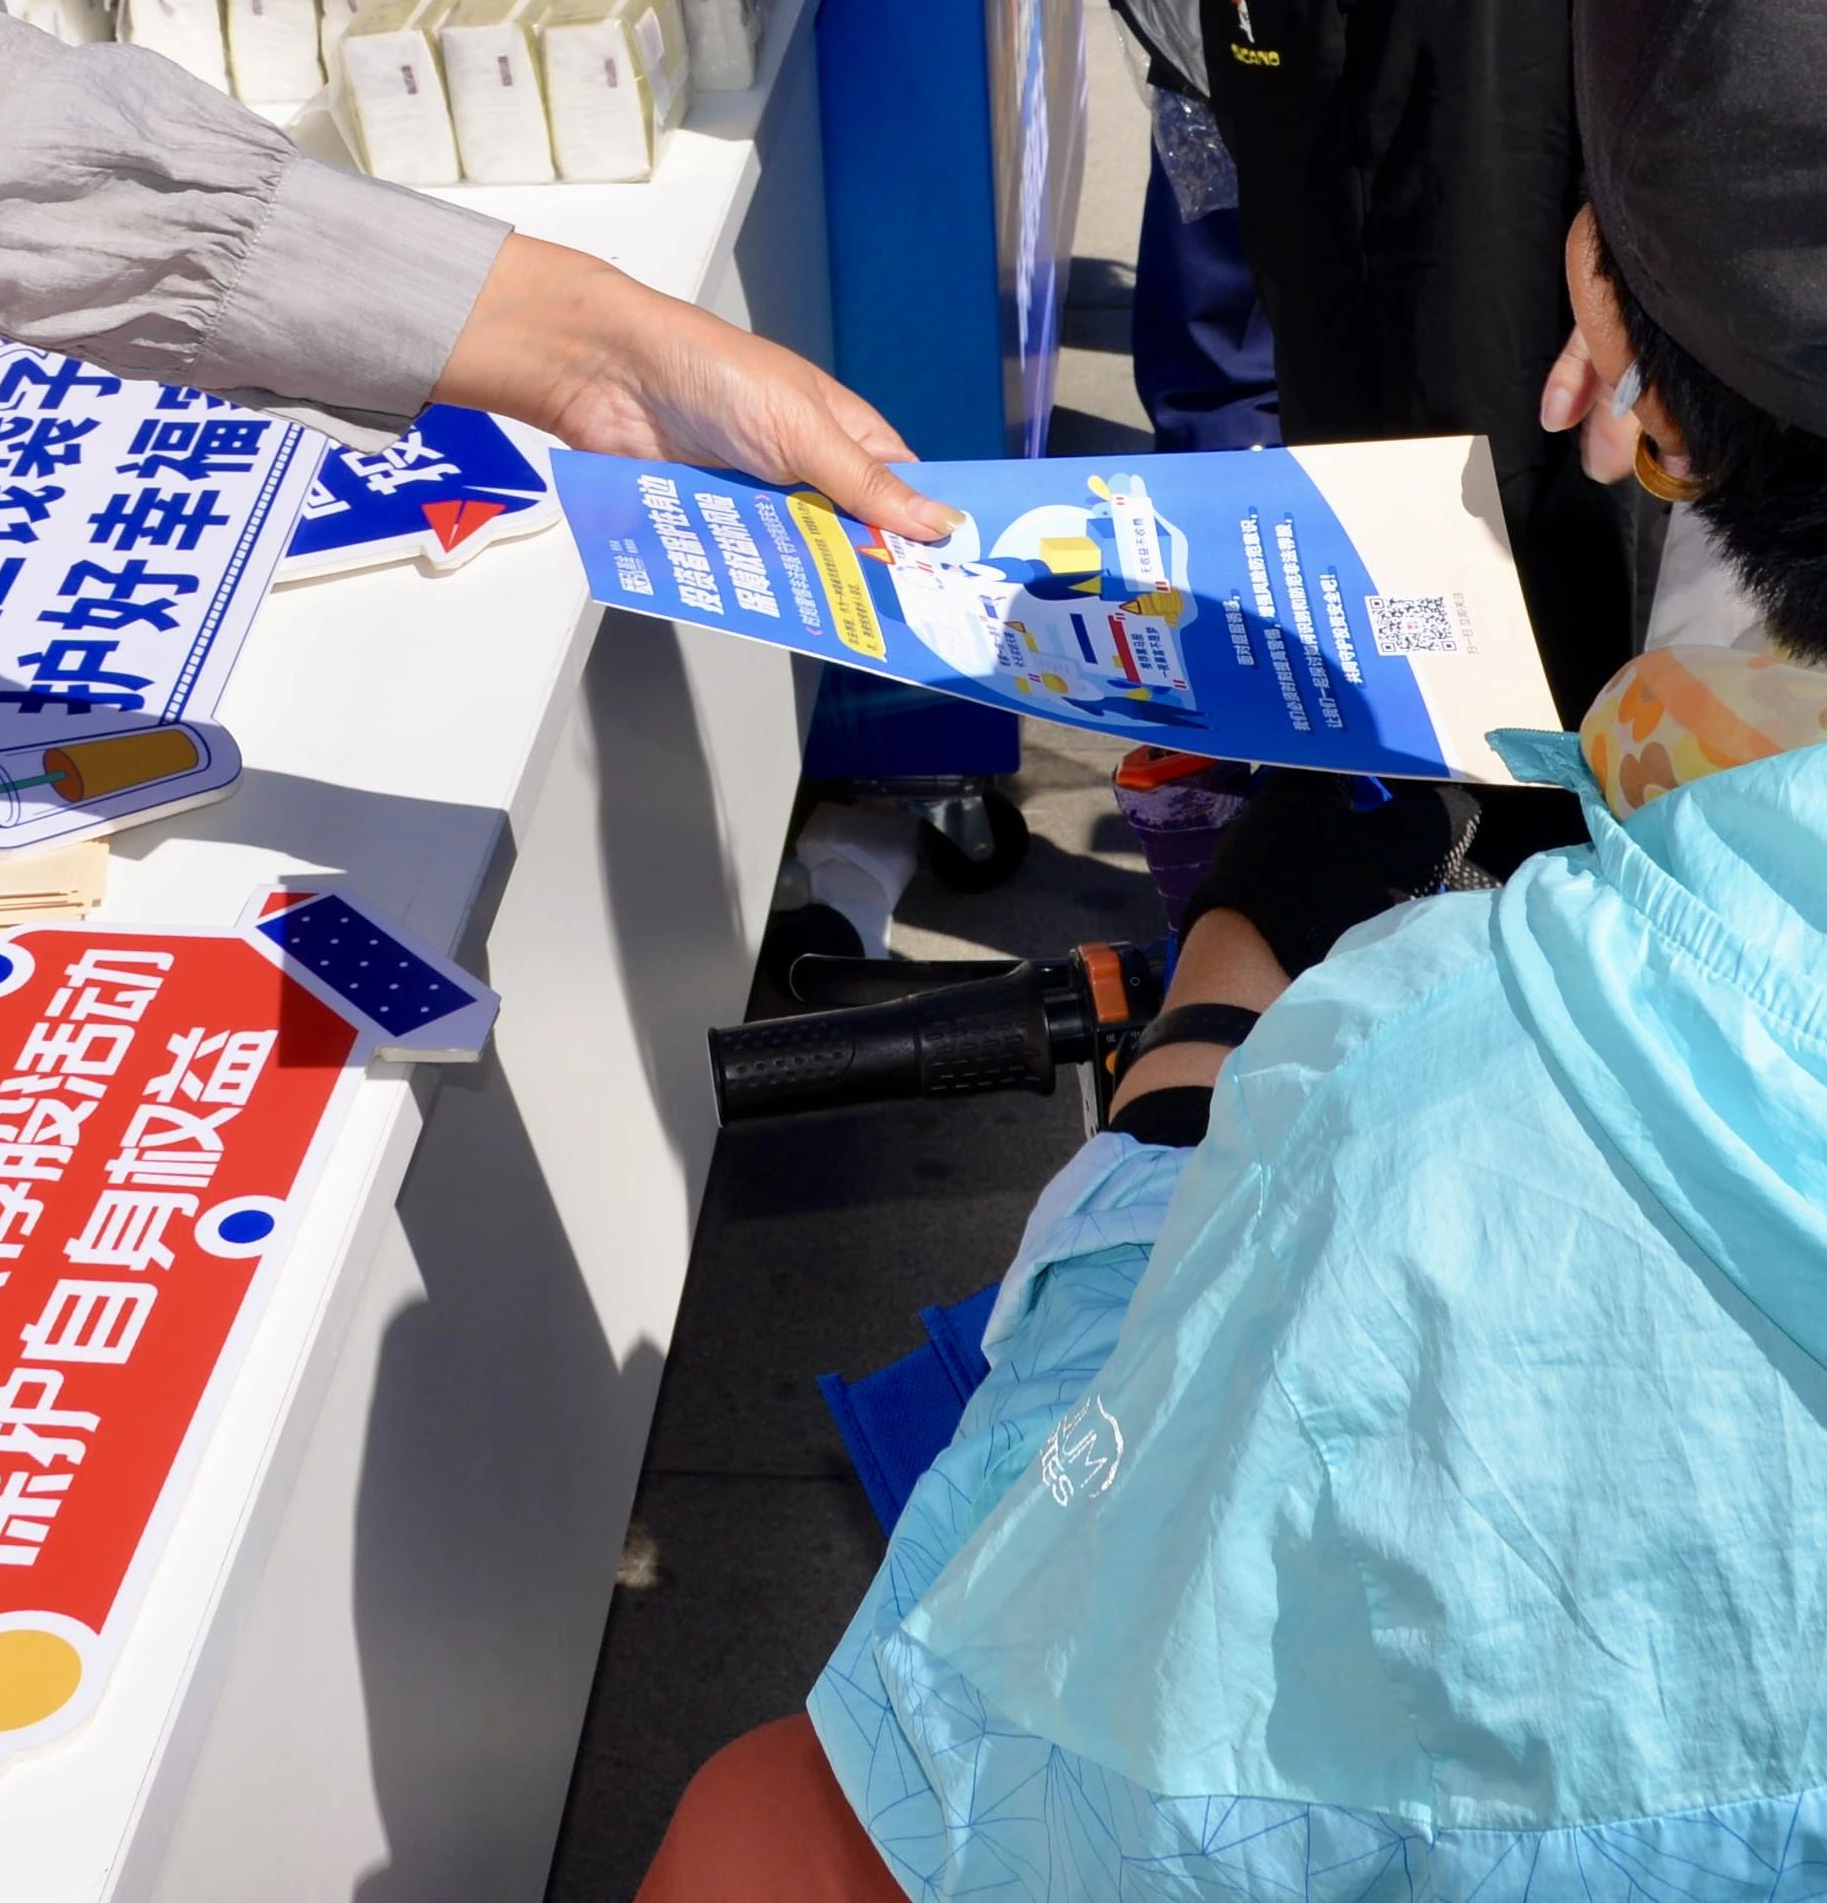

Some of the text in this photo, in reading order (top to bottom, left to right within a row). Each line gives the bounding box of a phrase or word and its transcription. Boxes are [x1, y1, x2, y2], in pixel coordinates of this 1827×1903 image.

[636, 474, 724, 615] 投资者保护在身边
[693, 492, 780, 618] 保障权益防风险
